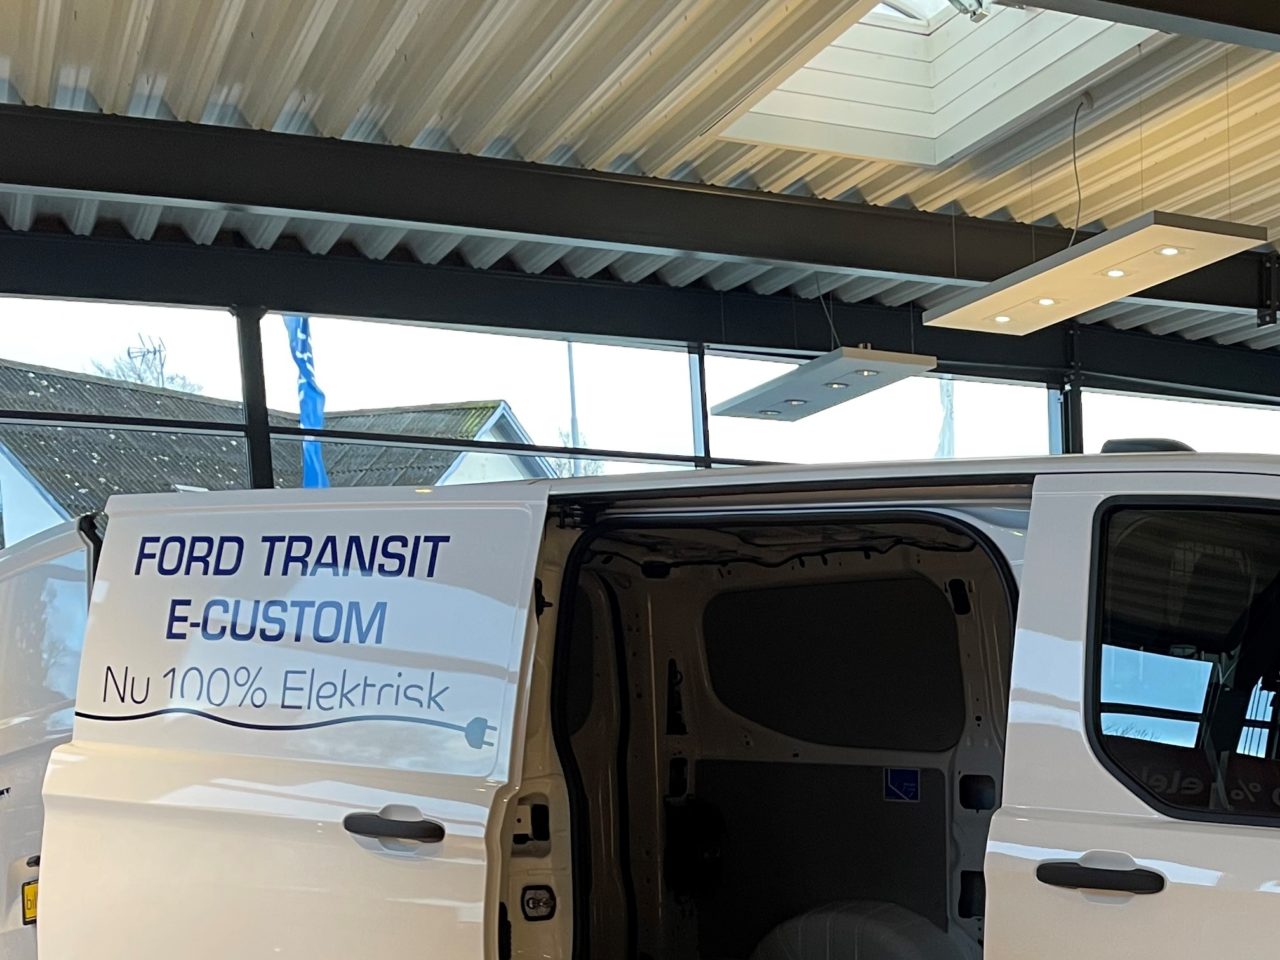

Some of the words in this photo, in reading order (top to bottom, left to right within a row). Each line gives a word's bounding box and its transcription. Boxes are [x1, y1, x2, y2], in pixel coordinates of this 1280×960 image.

[134, 535, 245, 576] FORD
[261, 534, 451, 578] TRANSIT
[166, 598, 389, 645] E-CUSTOM
[102, 665, 151, 705] Nu
[162, 665, 268, 710] 100%
[280, 668, 451, 713] Elektrisk
